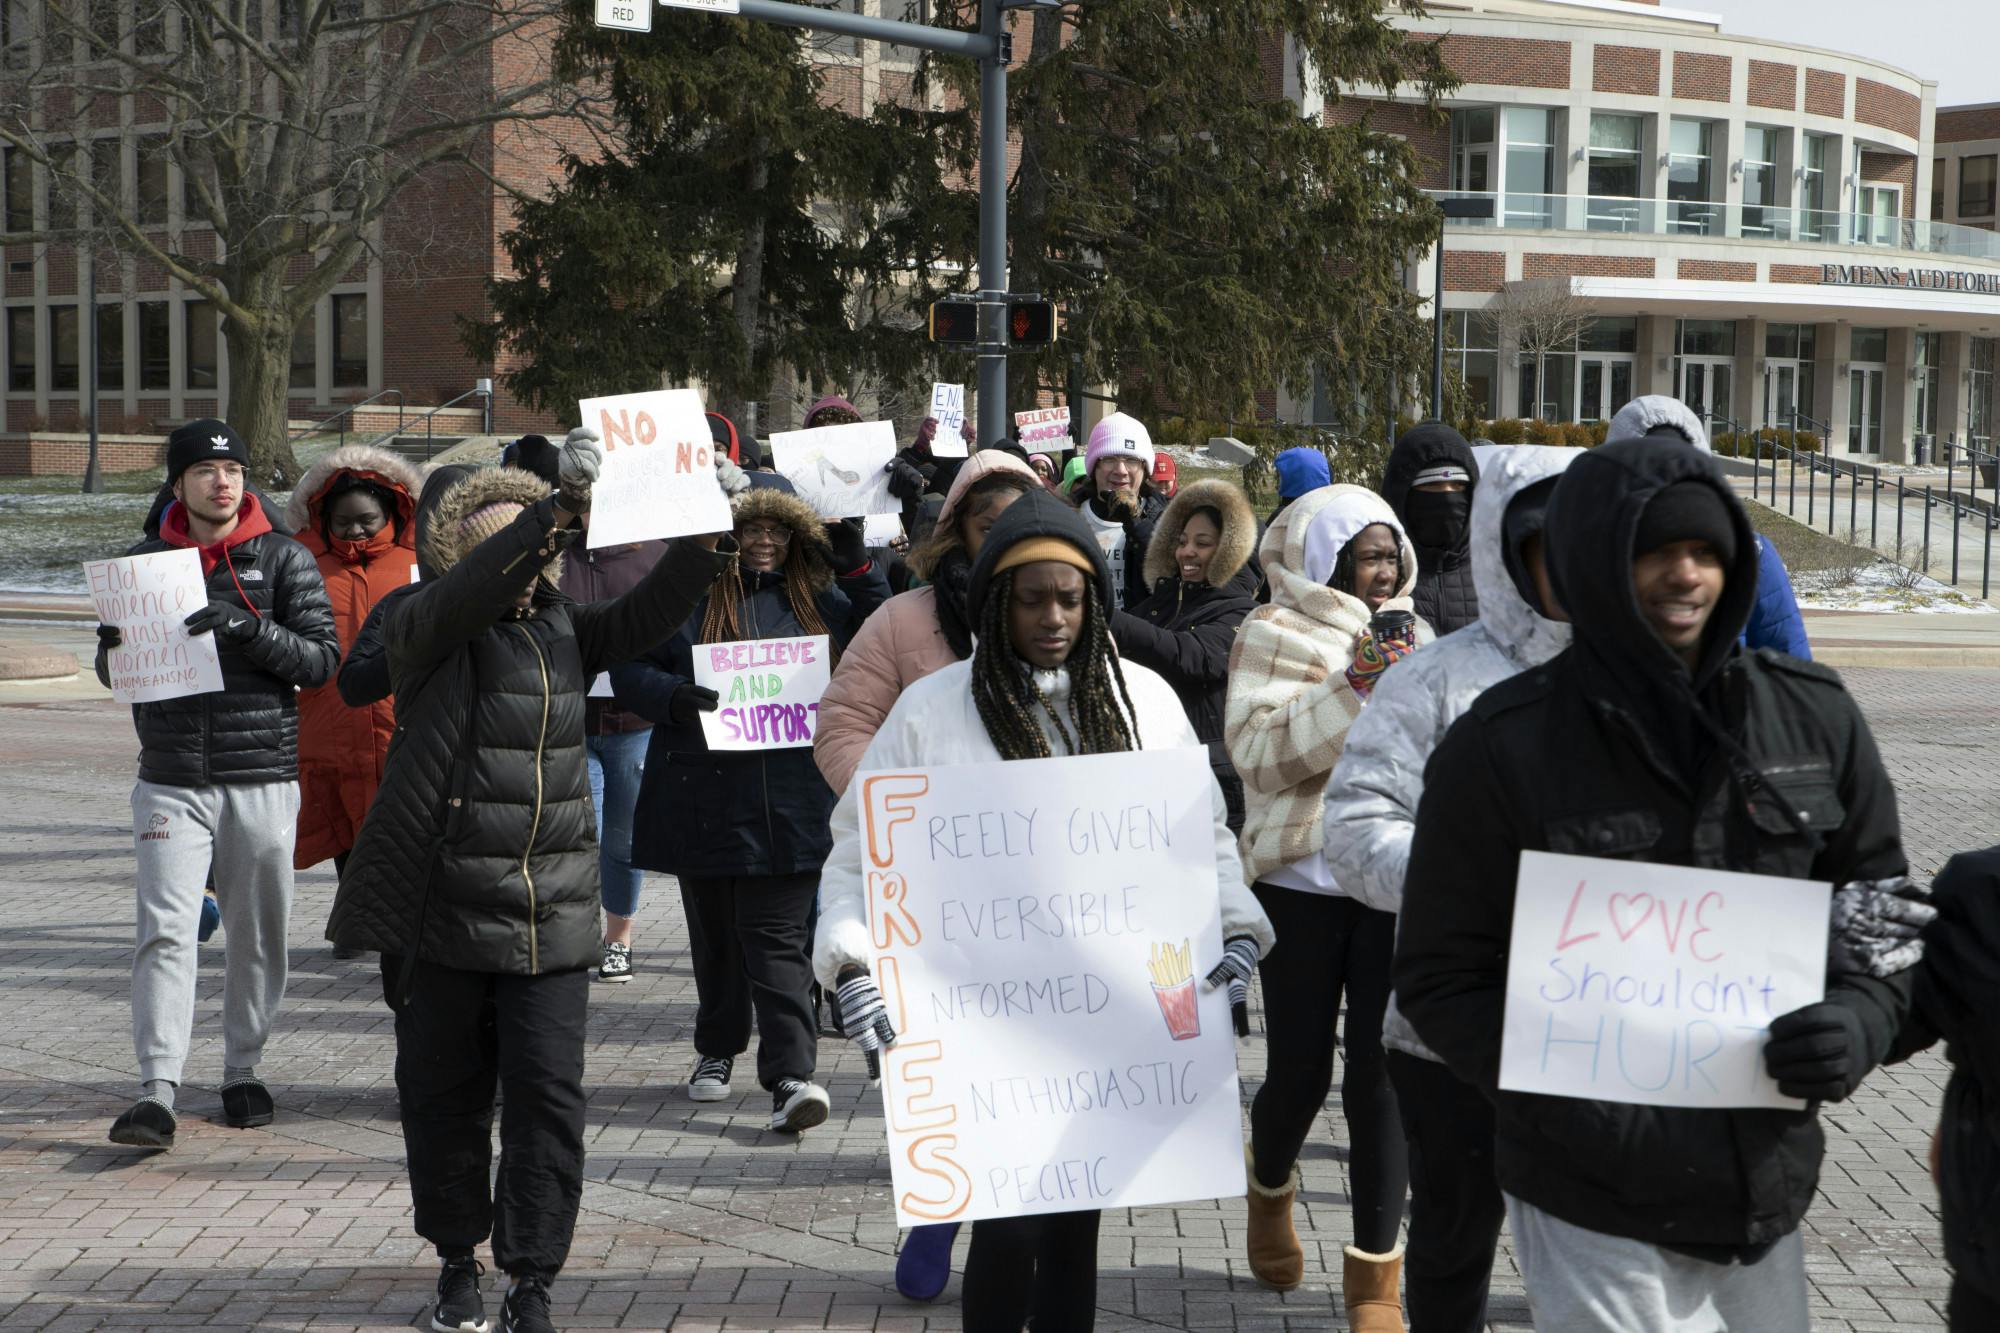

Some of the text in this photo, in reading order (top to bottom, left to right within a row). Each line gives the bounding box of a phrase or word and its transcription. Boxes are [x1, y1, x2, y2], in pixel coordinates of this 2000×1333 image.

[612, 7, 634, 21] RED
[1821, 263, 1900, 285] EMENS
[600, 408, 657, 452] NO
[933, 408, 962, 429] THE
[1016, 407, 1069, 425] BELIEVE
[89, 559, 139, 593] End
[120, 620, 172, 648] ainst
[710, 641, 816, 673] BELIEVE
[113, 666, 198, 690] #NOMEANSNO
[728, 673, 783, 703] AND
[1068, 800, 1171, 856] GIVEN
